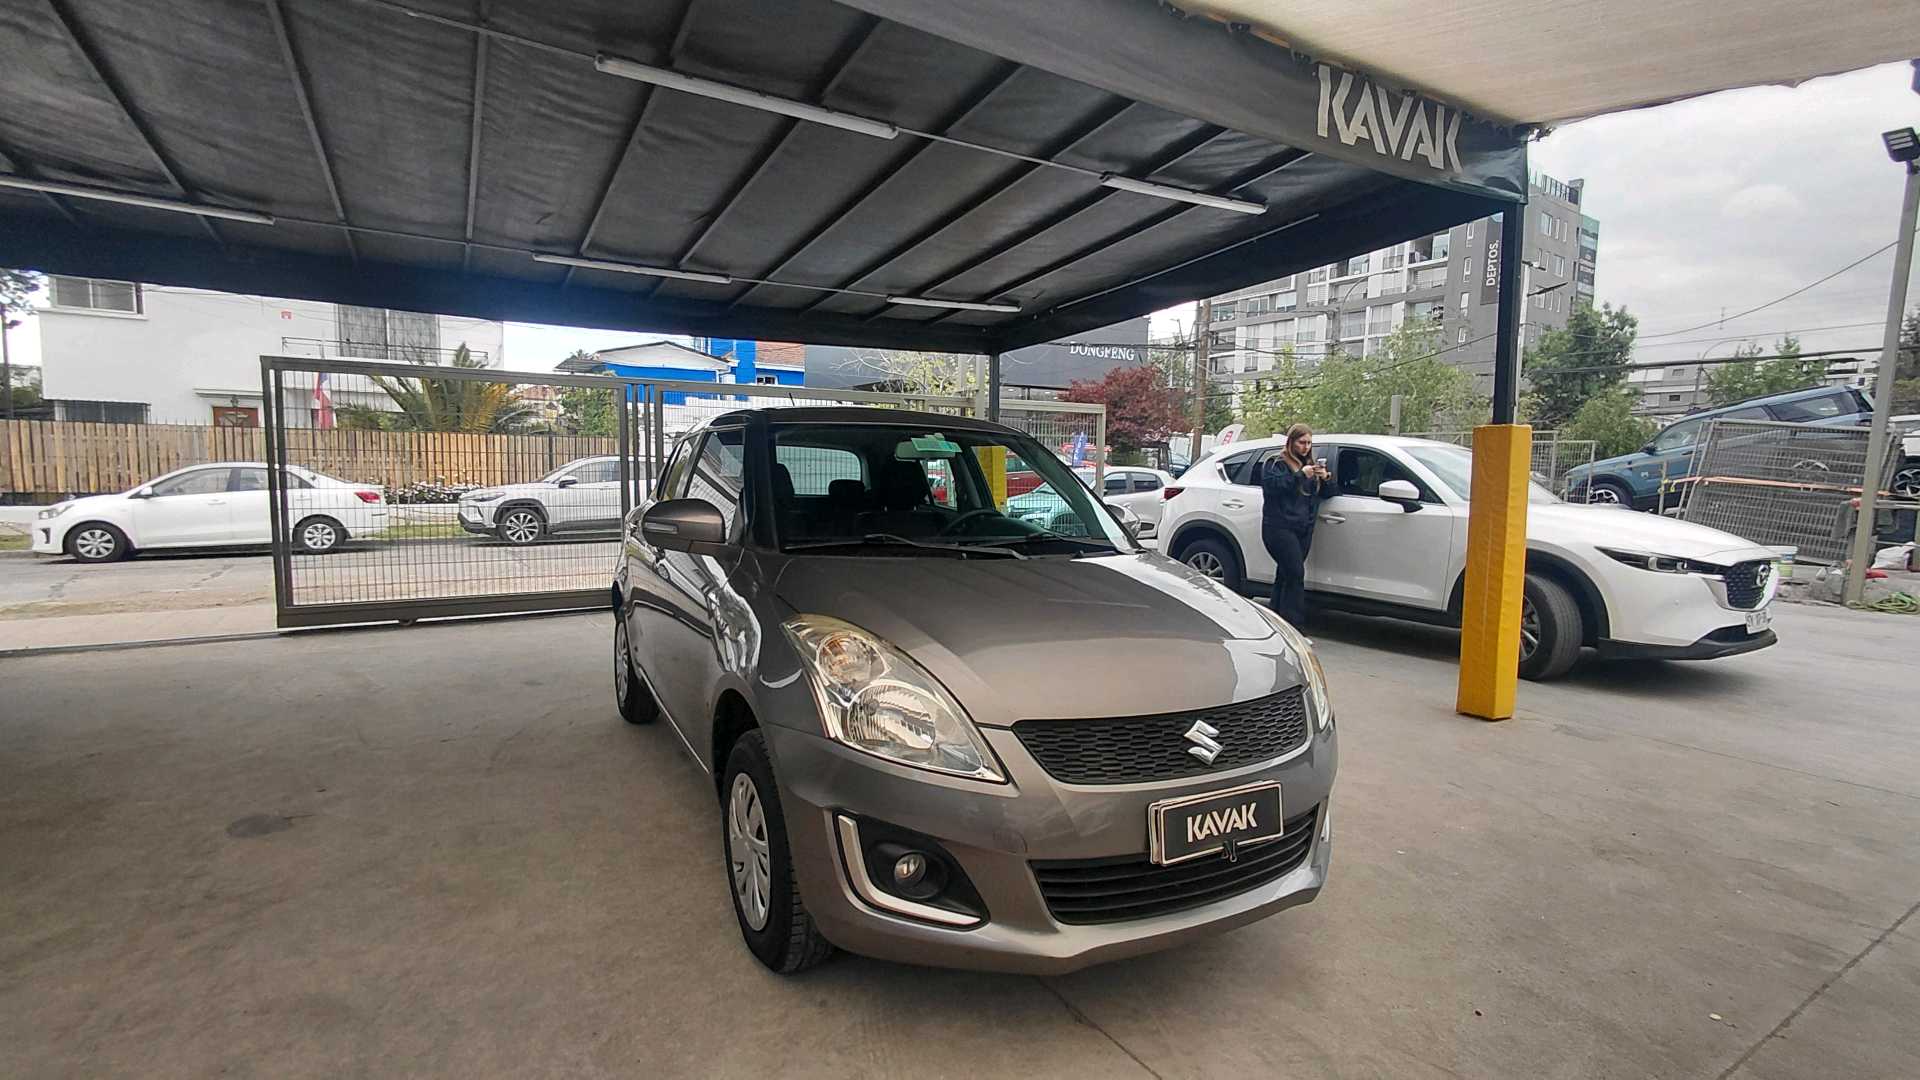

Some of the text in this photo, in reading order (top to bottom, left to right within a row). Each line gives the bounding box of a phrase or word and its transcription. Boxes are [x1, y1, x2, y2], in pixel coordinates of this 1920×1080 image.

[1317, 64, 1464, 175] KAVAK
[1069, 341, 1135, 361] DONGFENG
[1187, 802, 1258, 842] KAVAK
